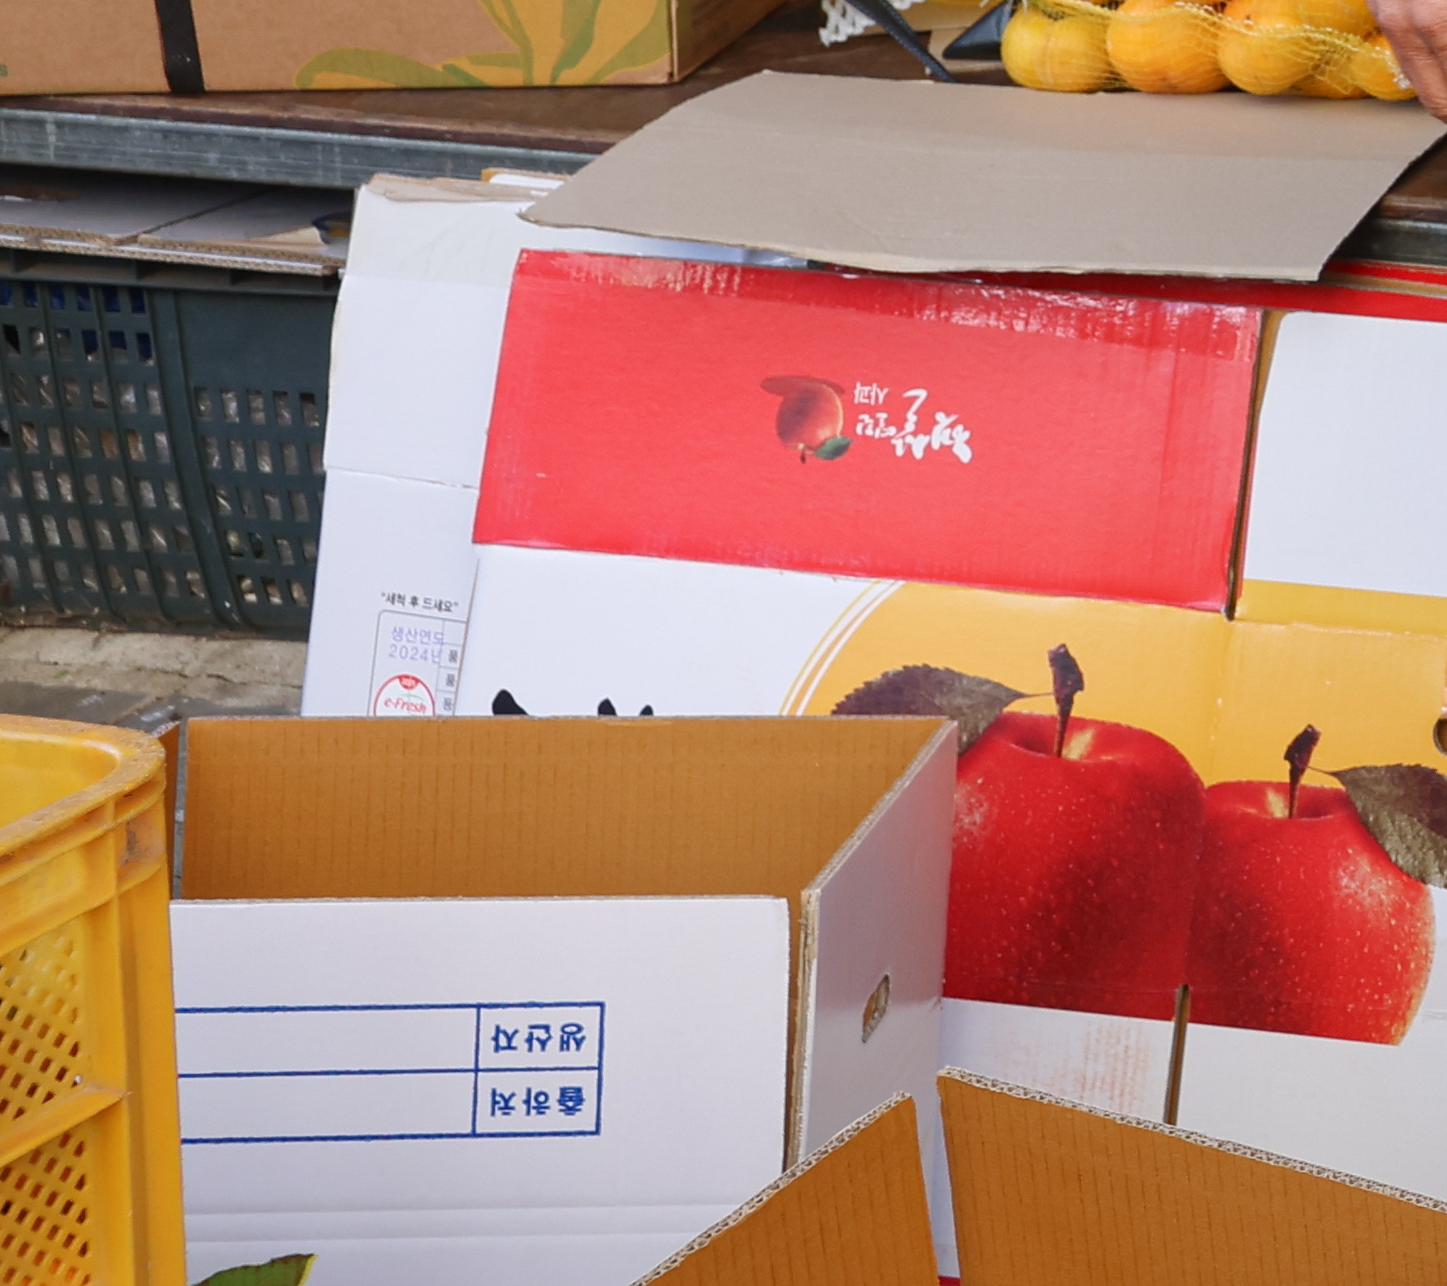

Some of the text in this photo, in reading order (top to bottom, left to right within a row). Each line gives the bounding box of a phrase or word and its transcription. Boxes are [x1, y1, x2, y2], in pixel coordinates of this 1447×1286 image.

[392, 627, 444, 646] 생산연도
[384, 697, 427, 714] e-Fresh
[491, 1023, 586, 1052] 생산자
[490, 1087, 586, 1117] 출하처
